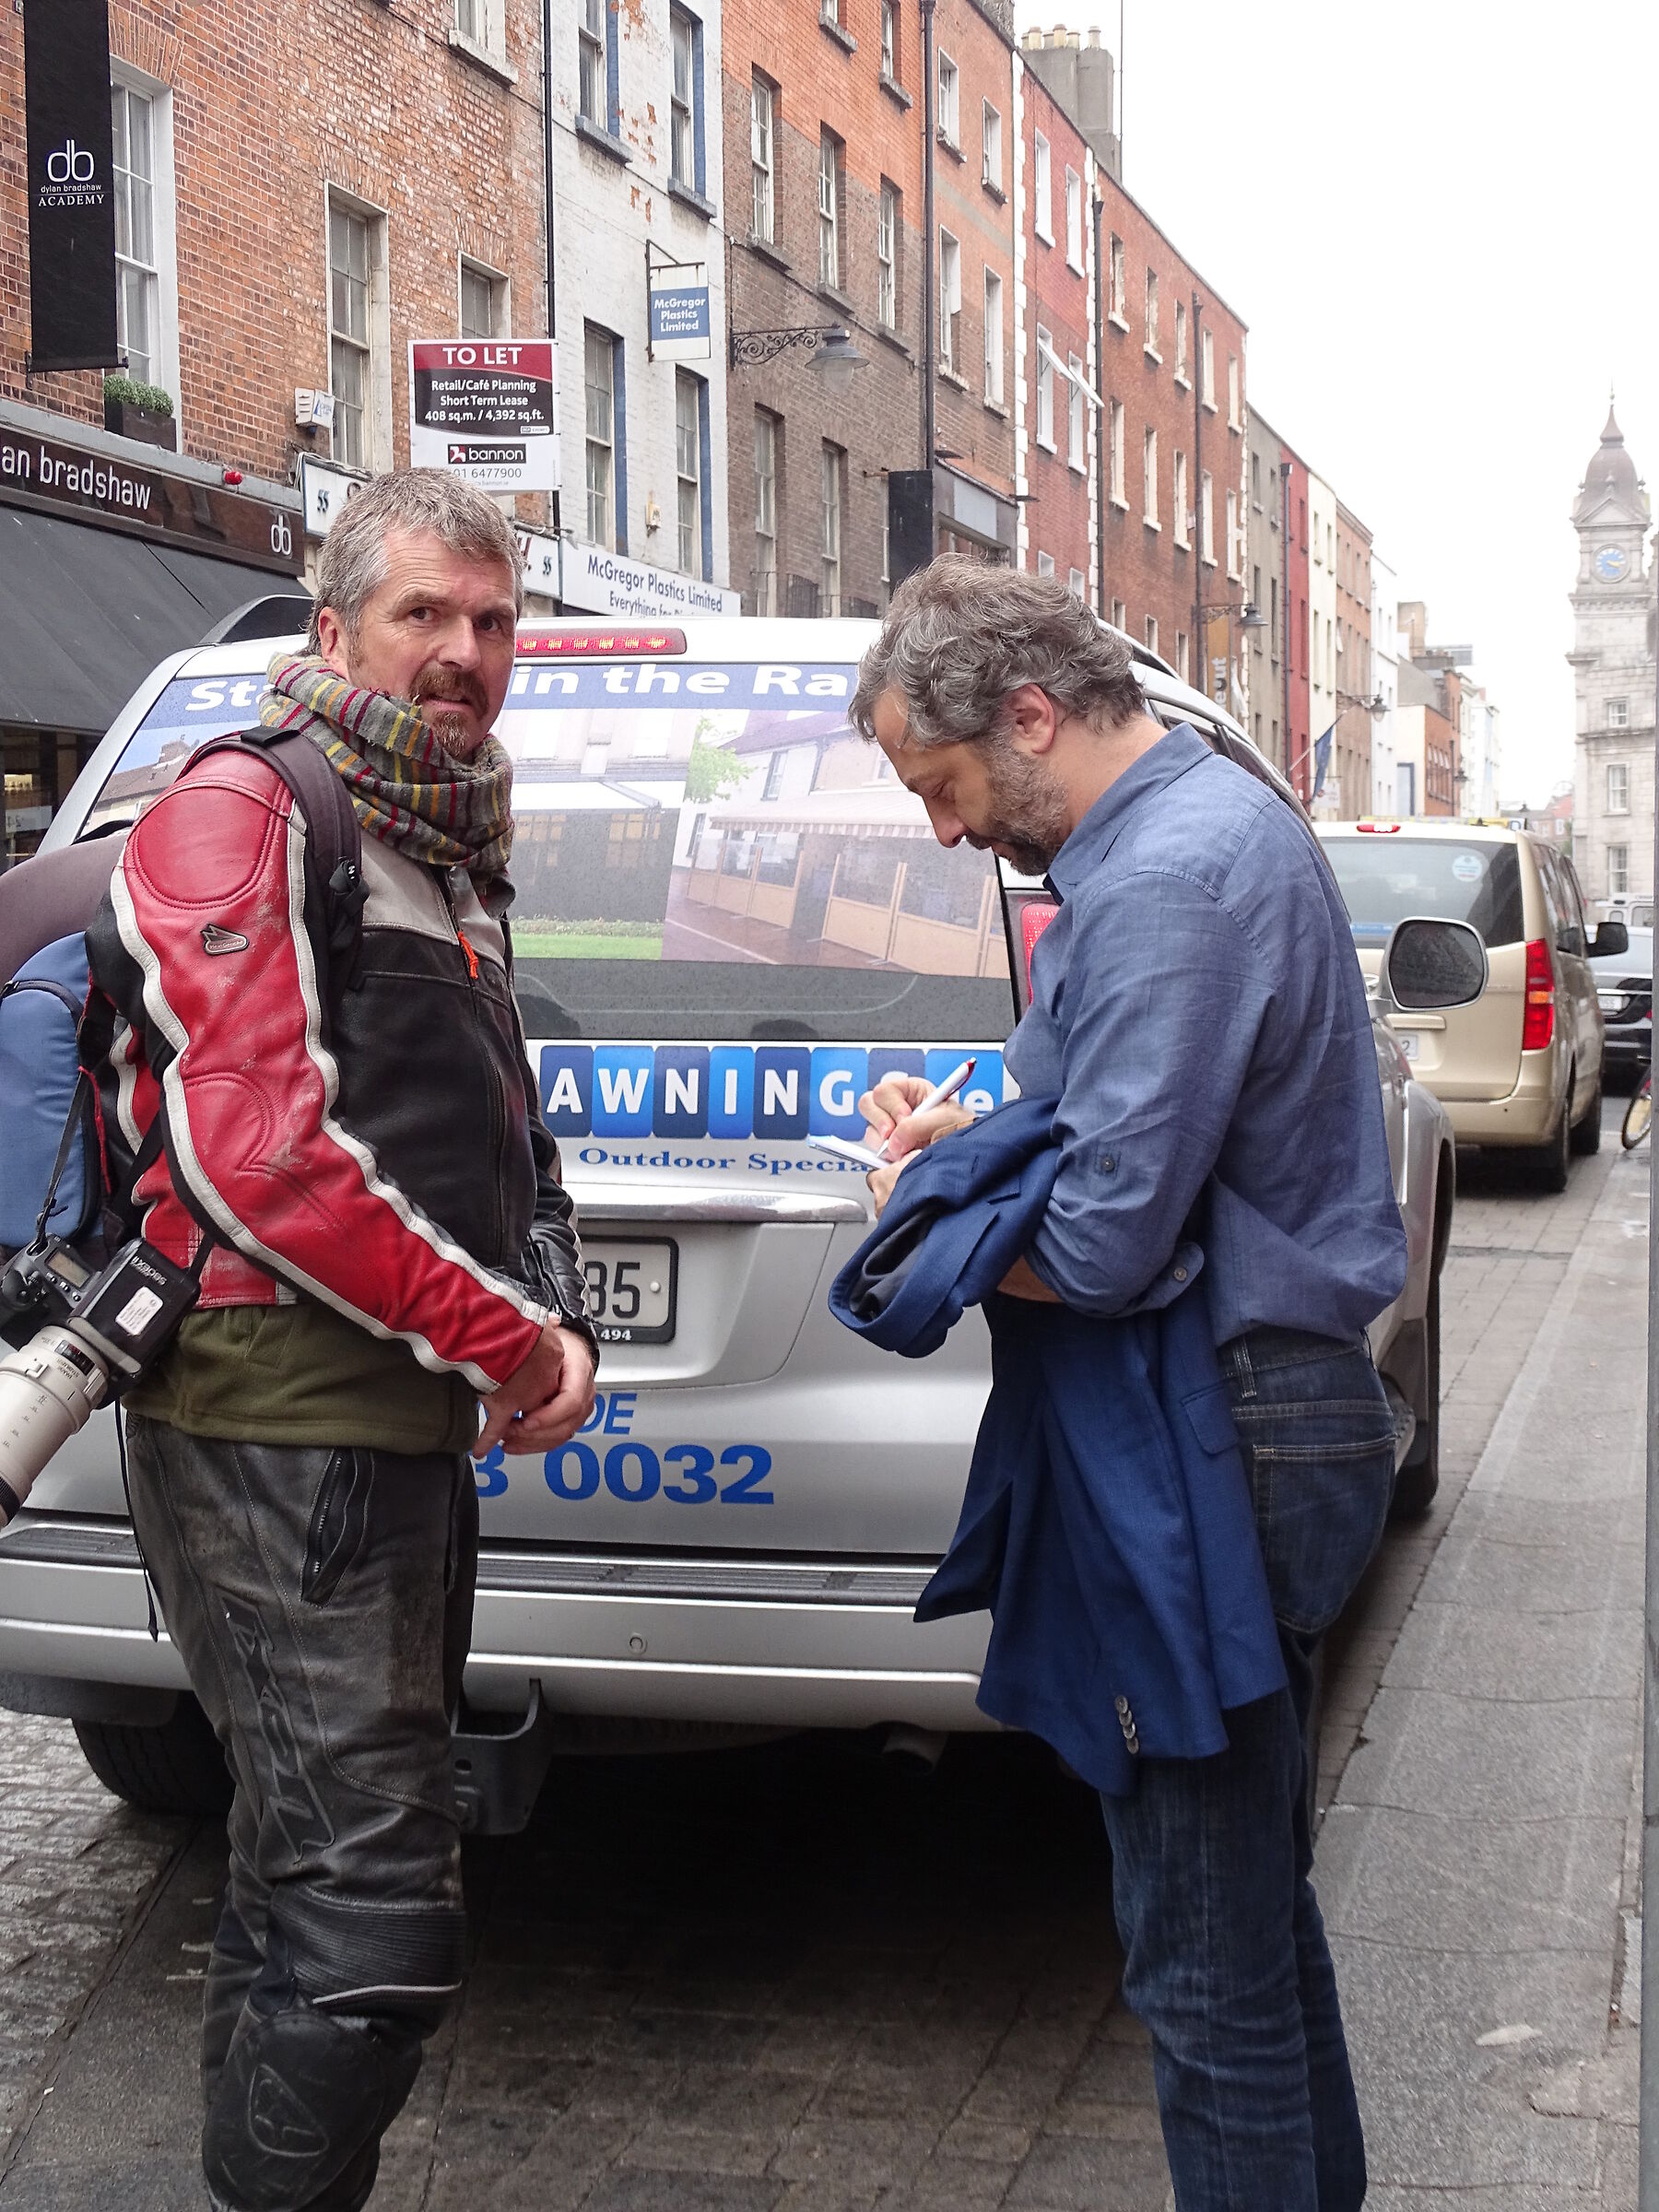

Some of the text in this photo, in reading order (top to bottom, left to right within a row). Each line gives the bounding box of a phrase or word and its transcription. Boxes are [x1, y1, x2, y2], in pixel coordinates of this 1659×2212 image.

[47, 139, 95, 182] db
[41, 183, 102, 194] dylan bradshaw
[38, 194, 104, 206] ACADEMY
[653, 298, 706, 310] McGregor
[660, 309, 699, 321] Plastics
[660, 320, 700, 333] Limited
[442, 347, 523, 366] TO LET
[431, 379, 536, 394] Retail/Café Planning
[440, 394, 529, 406] Short Term Lease
[424, 408, 545, 424] 408 sq.m. / 4,392 sq.ft.
[468, 447, 524, 462] bannon
[39, 444, 151, 511] bradshaw
[471, 468, 523, 478] 6477900
[587, 554, 645, 592] McGregor
[647, 572, 685, 602] Plastics
[688, 585, 723, 613] Limited
[184, 680, 275, 712] St
[510, 665, 579, 695] in
[602, 664, 731, 696] the
[547, 1067, 909, 1117] AWNING
[579, 1147, 736, 1170] Outdoor
[583, 1261, 641, 1319] 85
[600, 1328, 632, 1341] 494
[544, 1440, 774, 1505] 0032
